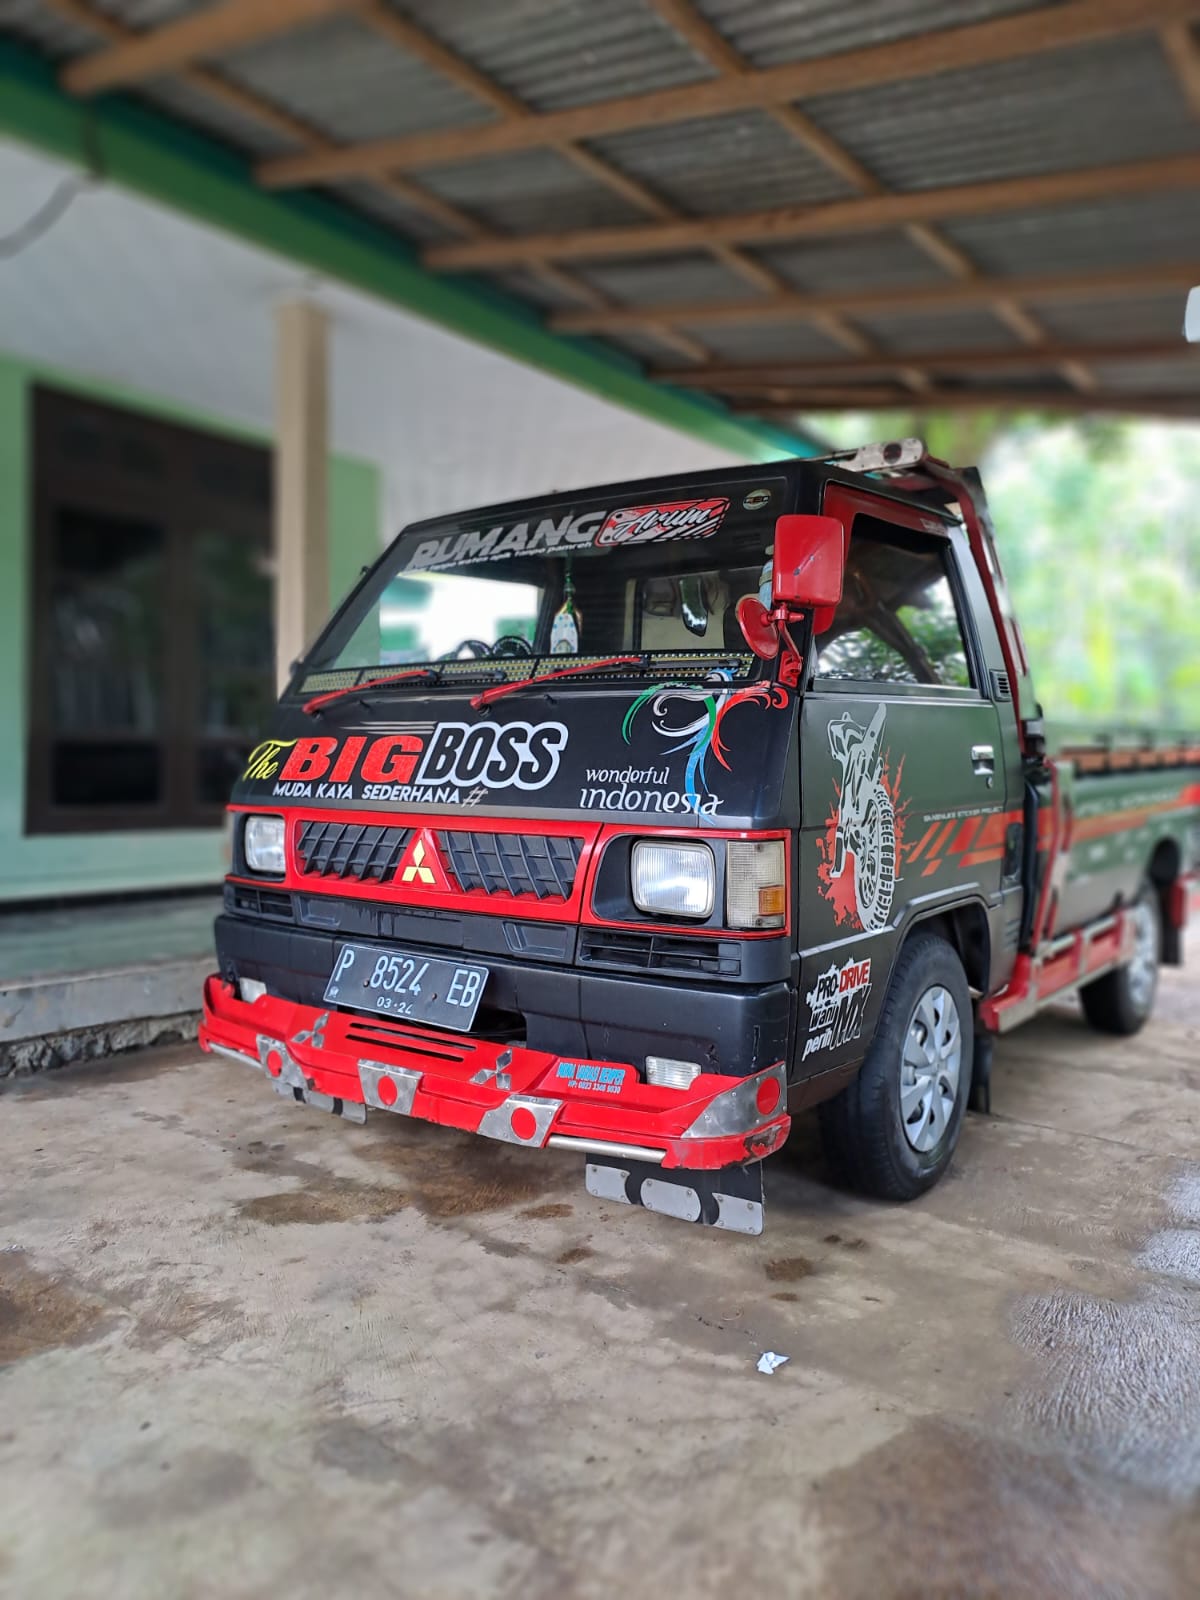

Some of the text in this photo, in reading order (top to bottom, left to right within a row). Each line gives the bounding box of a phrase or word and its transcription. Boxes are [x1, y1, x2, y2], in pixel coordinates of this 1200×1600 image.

[242, 721, 569, 790] The BIG BOSS
[585, 766, 670, 785] wonderful
[272, 783, 312, 799] MUDA
[315, 784, 353, 801] KAYA
[361, 784, 460, 804] SEDERHANA
[579, 783, 725, 816] indonesia
[335, 949, 481, 1008] P 8524 EB
